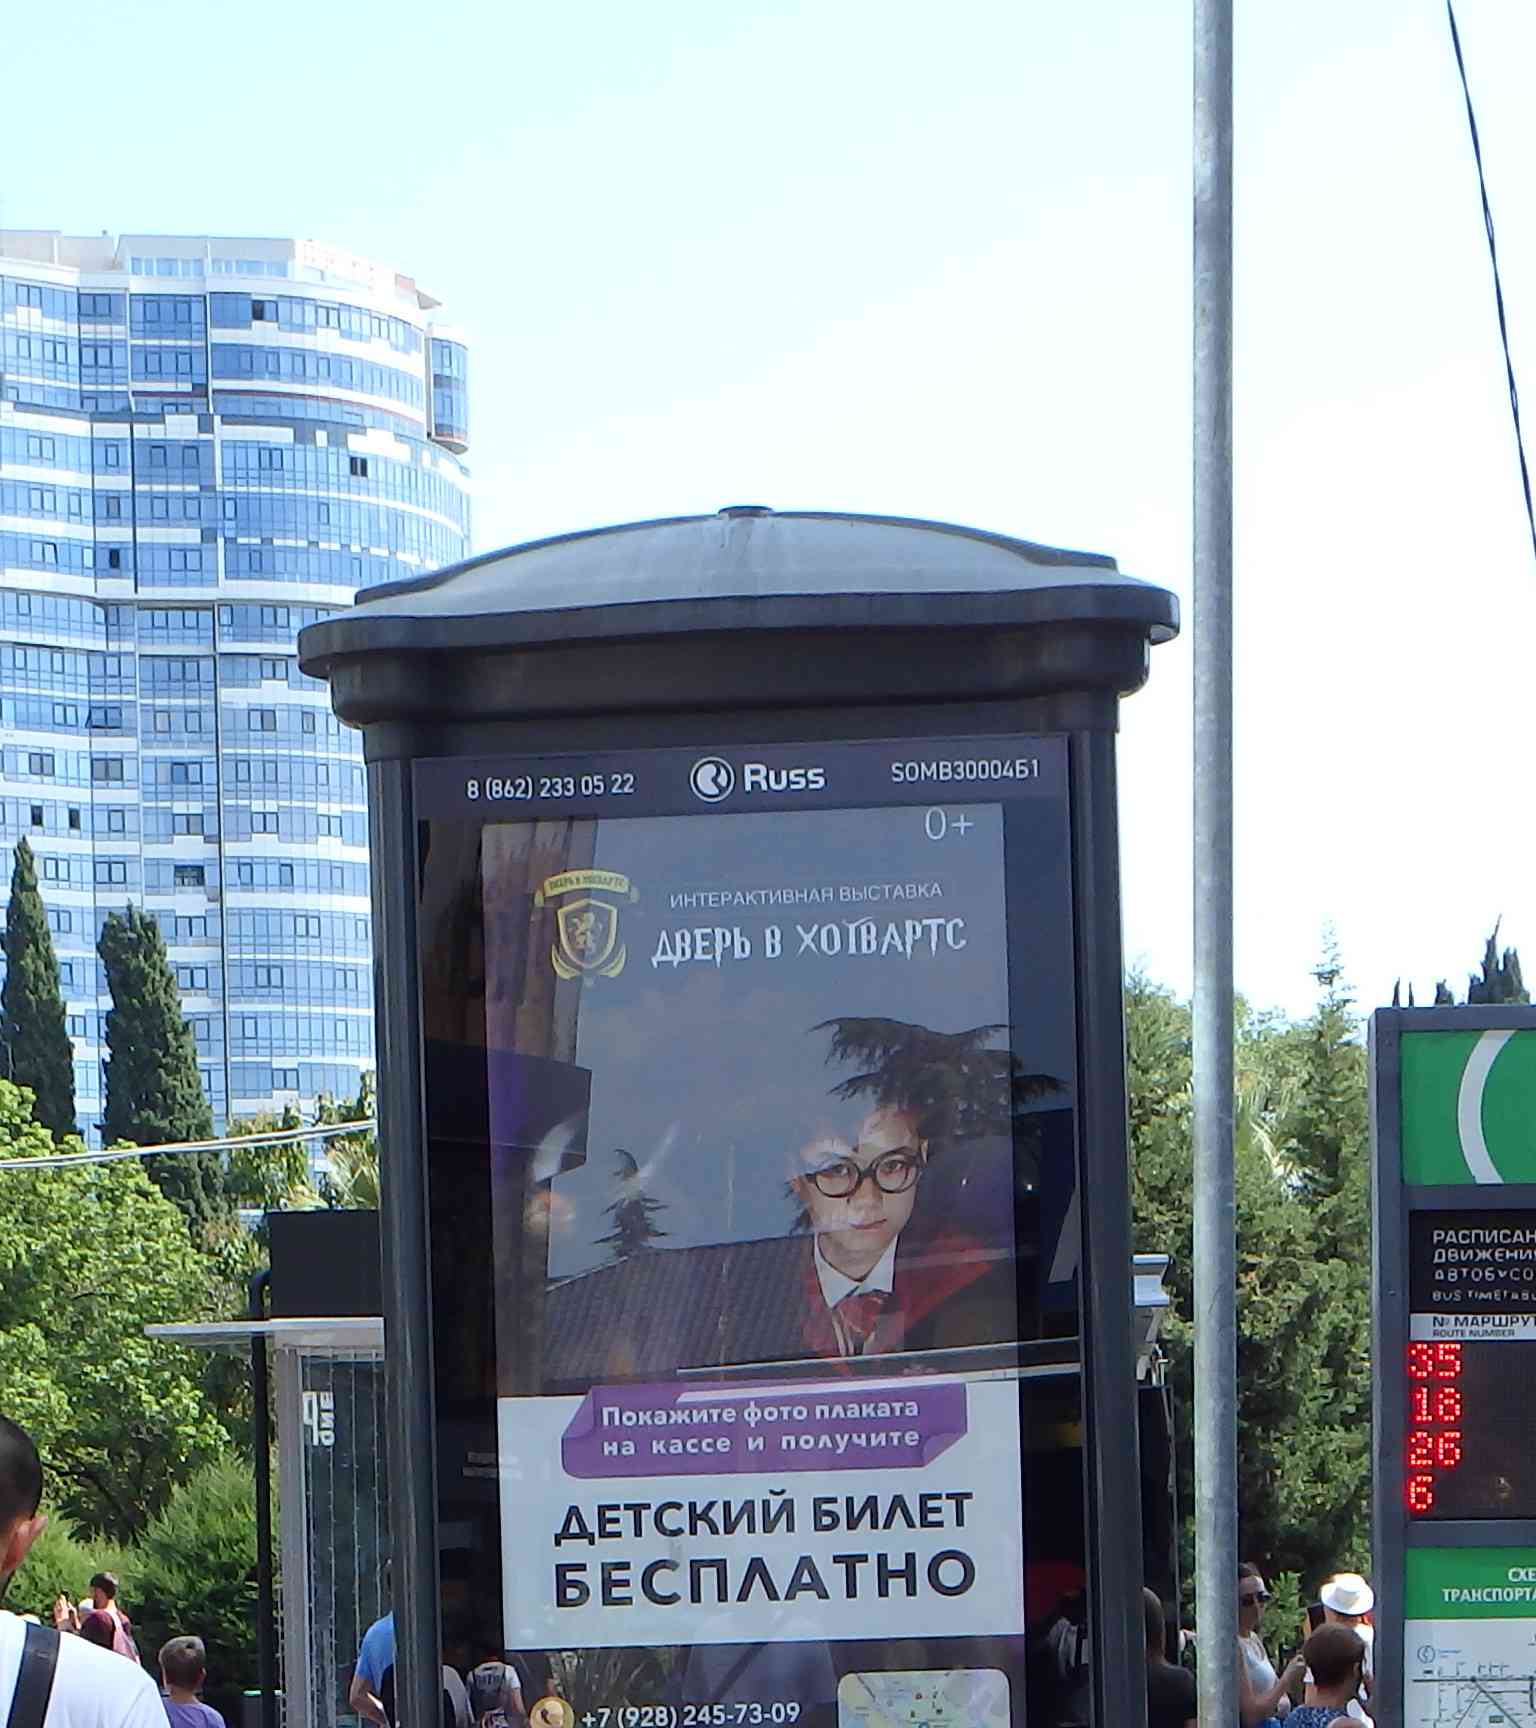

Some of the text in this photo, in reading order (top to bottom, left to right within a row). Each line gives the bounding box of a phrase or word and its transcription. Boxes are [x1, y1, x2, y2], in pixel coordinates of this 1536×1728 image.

[466, 772, 635, 801] 8 (862) 233 05 22
[743, 763, 827, 792] Russ
[924, 806, 974, 841] 0+
[670, 882, 945, 910] ИНТЕРАКТИВНАЯ ВЫСТАВКА
[651, 915, 967, 969] ДВЕРЬ В ХОГВАРТС
[1433, 1289, 1462, 1302] BUS
[1410, 1343, 1462, 1378] 35
[602, 1400, 919, 1428] Покажите фото плаката
[1415, 1386, 1462, 1422] 18
[603, 1430, 920, 1456] на кассе и получите
[1410, 1430, 1462, 1466] 26
[1409, 1475, 1434, 1510] 6
[554, 1488, 974, 1547] ДЕТСКИЙ БИЛЕТ
[554, 1549, 976, 1608] БЕСПЛАТНО
[581, 1708, 611, 1728] +7
[683, 1702, 801, 1726] 245-73-09
